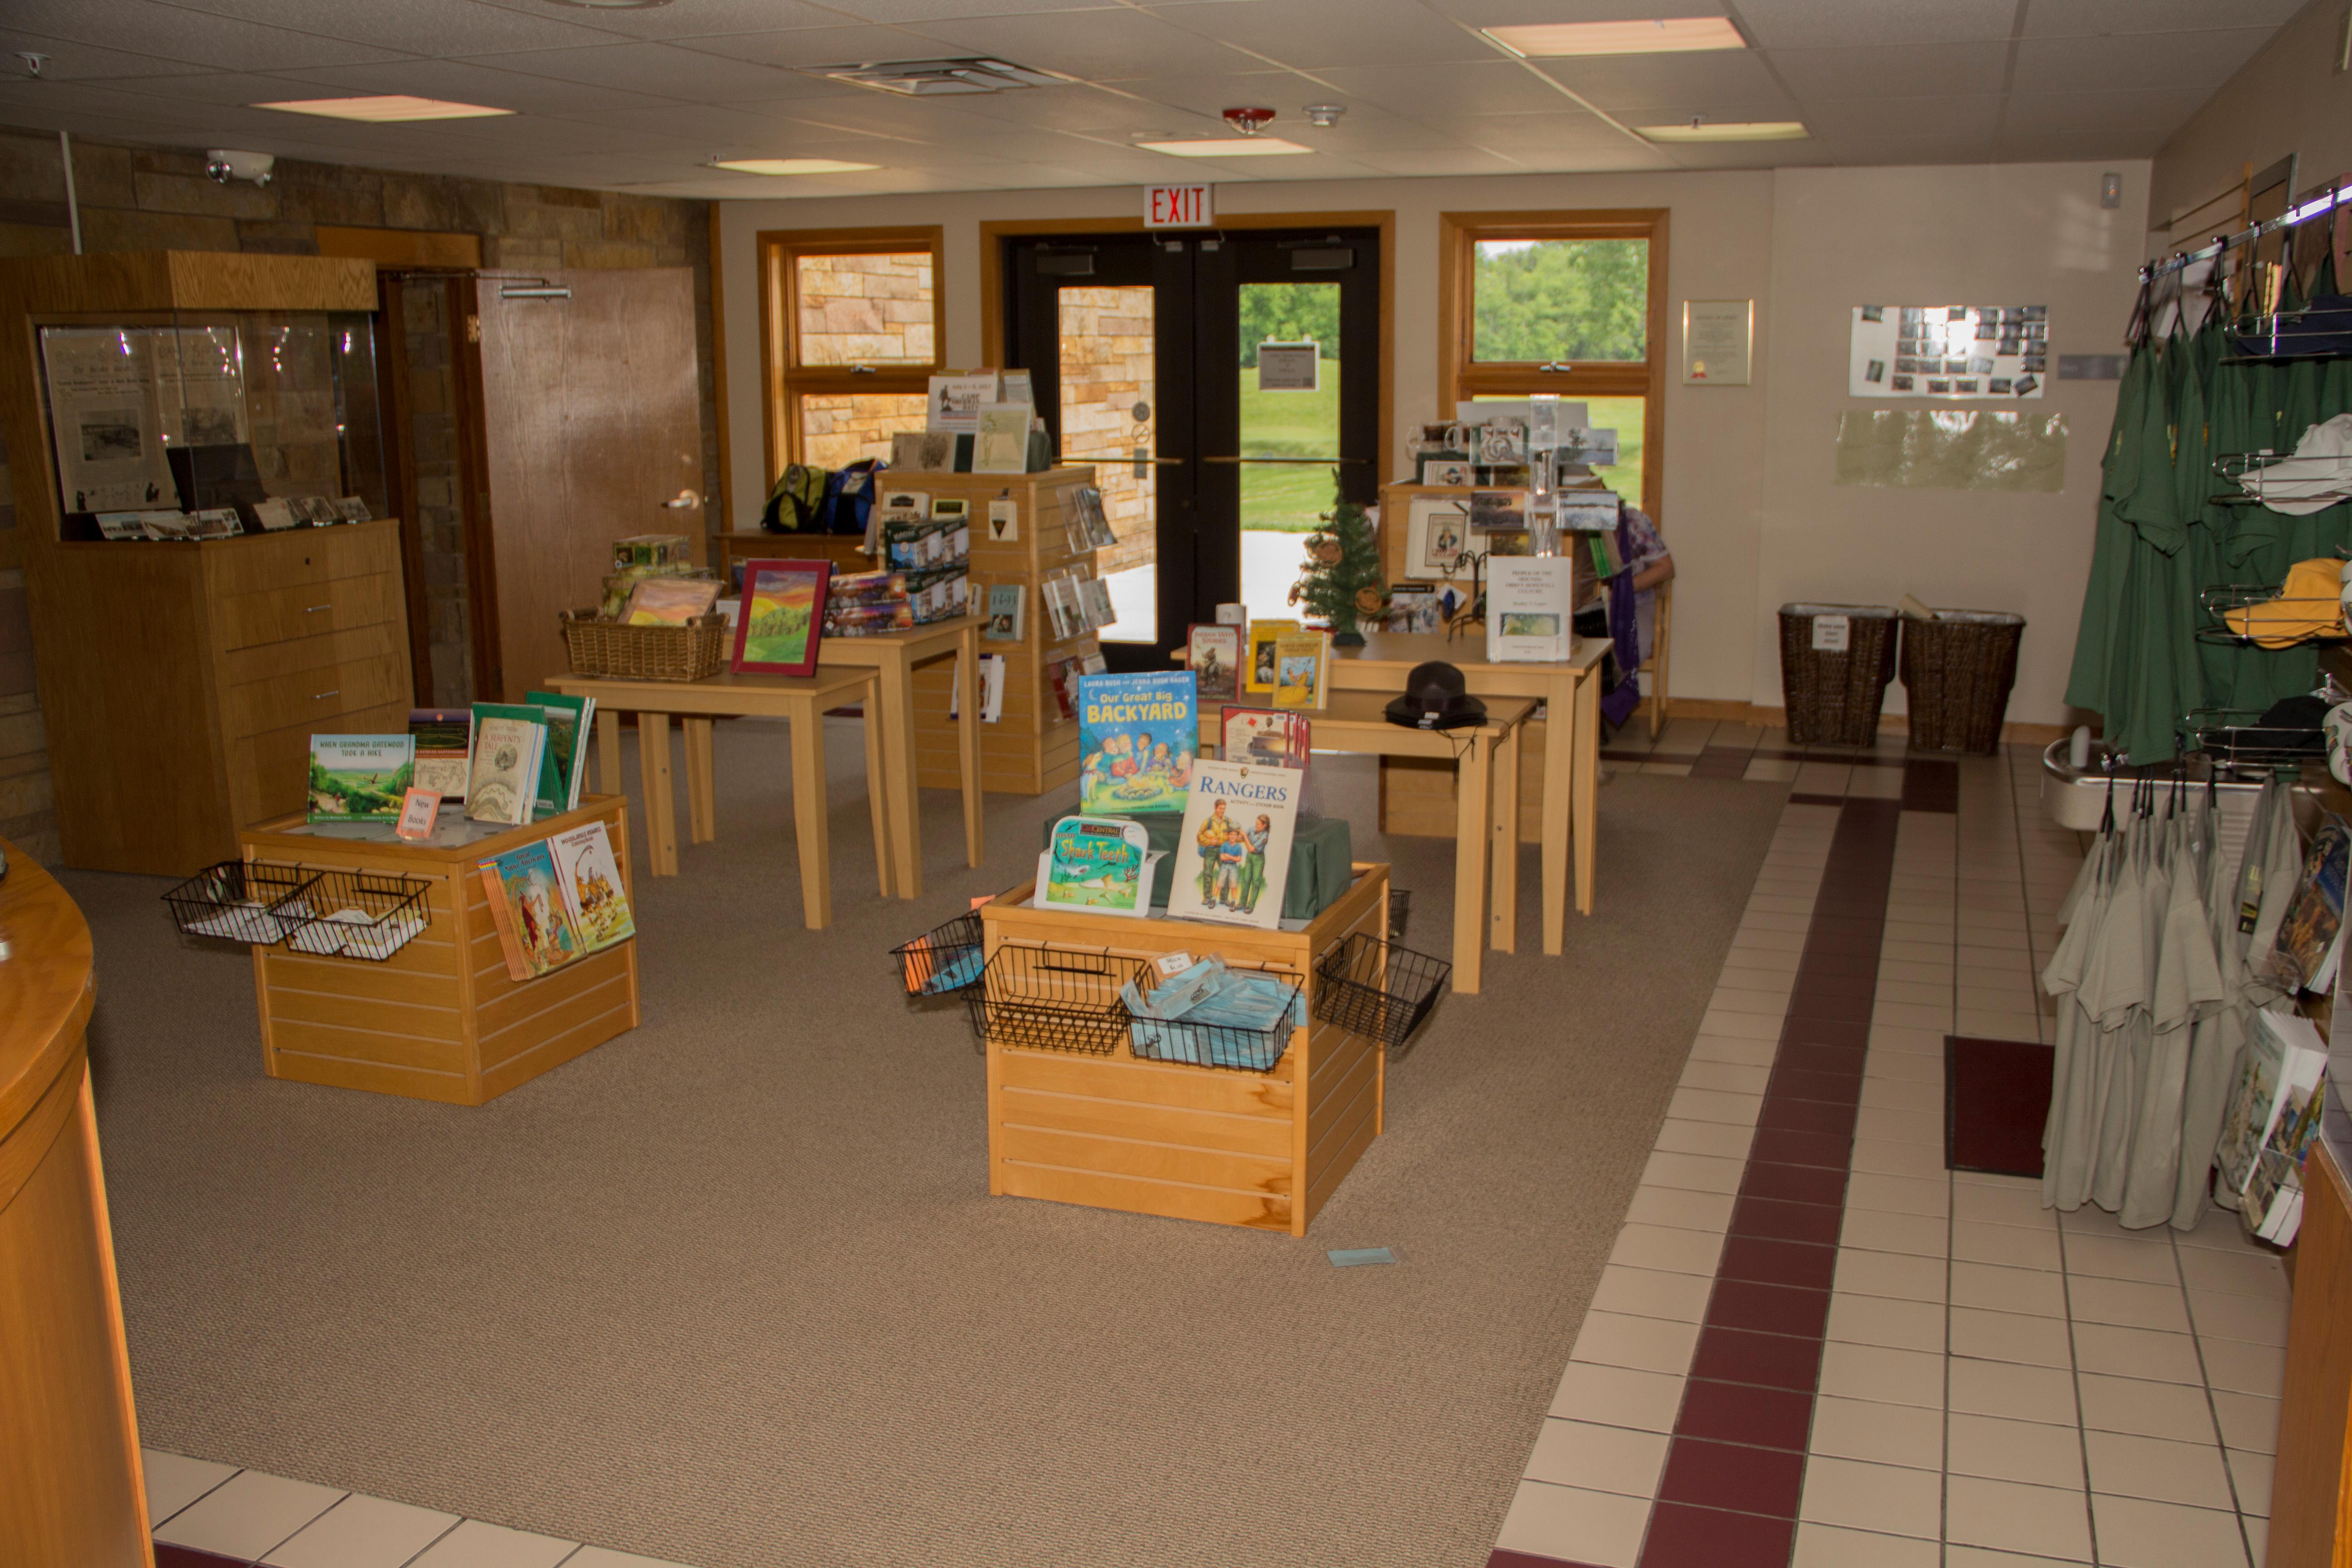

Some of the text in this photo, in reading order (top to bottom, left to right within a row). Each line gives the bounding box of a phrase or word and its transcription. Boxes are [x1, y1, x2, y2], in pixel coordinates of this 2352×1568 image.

[1153, 188, 1204, 223] EXIT
[1100, 691, 1172, 704] Our Great Big
[1087, 701, 1187, 724] BACKYARD
[485, 742, 498, 750] TALE
[1199, 775, 1288, 801] RANGERS
[416, 798, 430, 809] New
[407, 814, 427, 825] Books
[516, 851, 530, 861] Great
[1061, 839, 1130, 863] Shark Teeth
[505, 853, 545, 872] Native Americans
